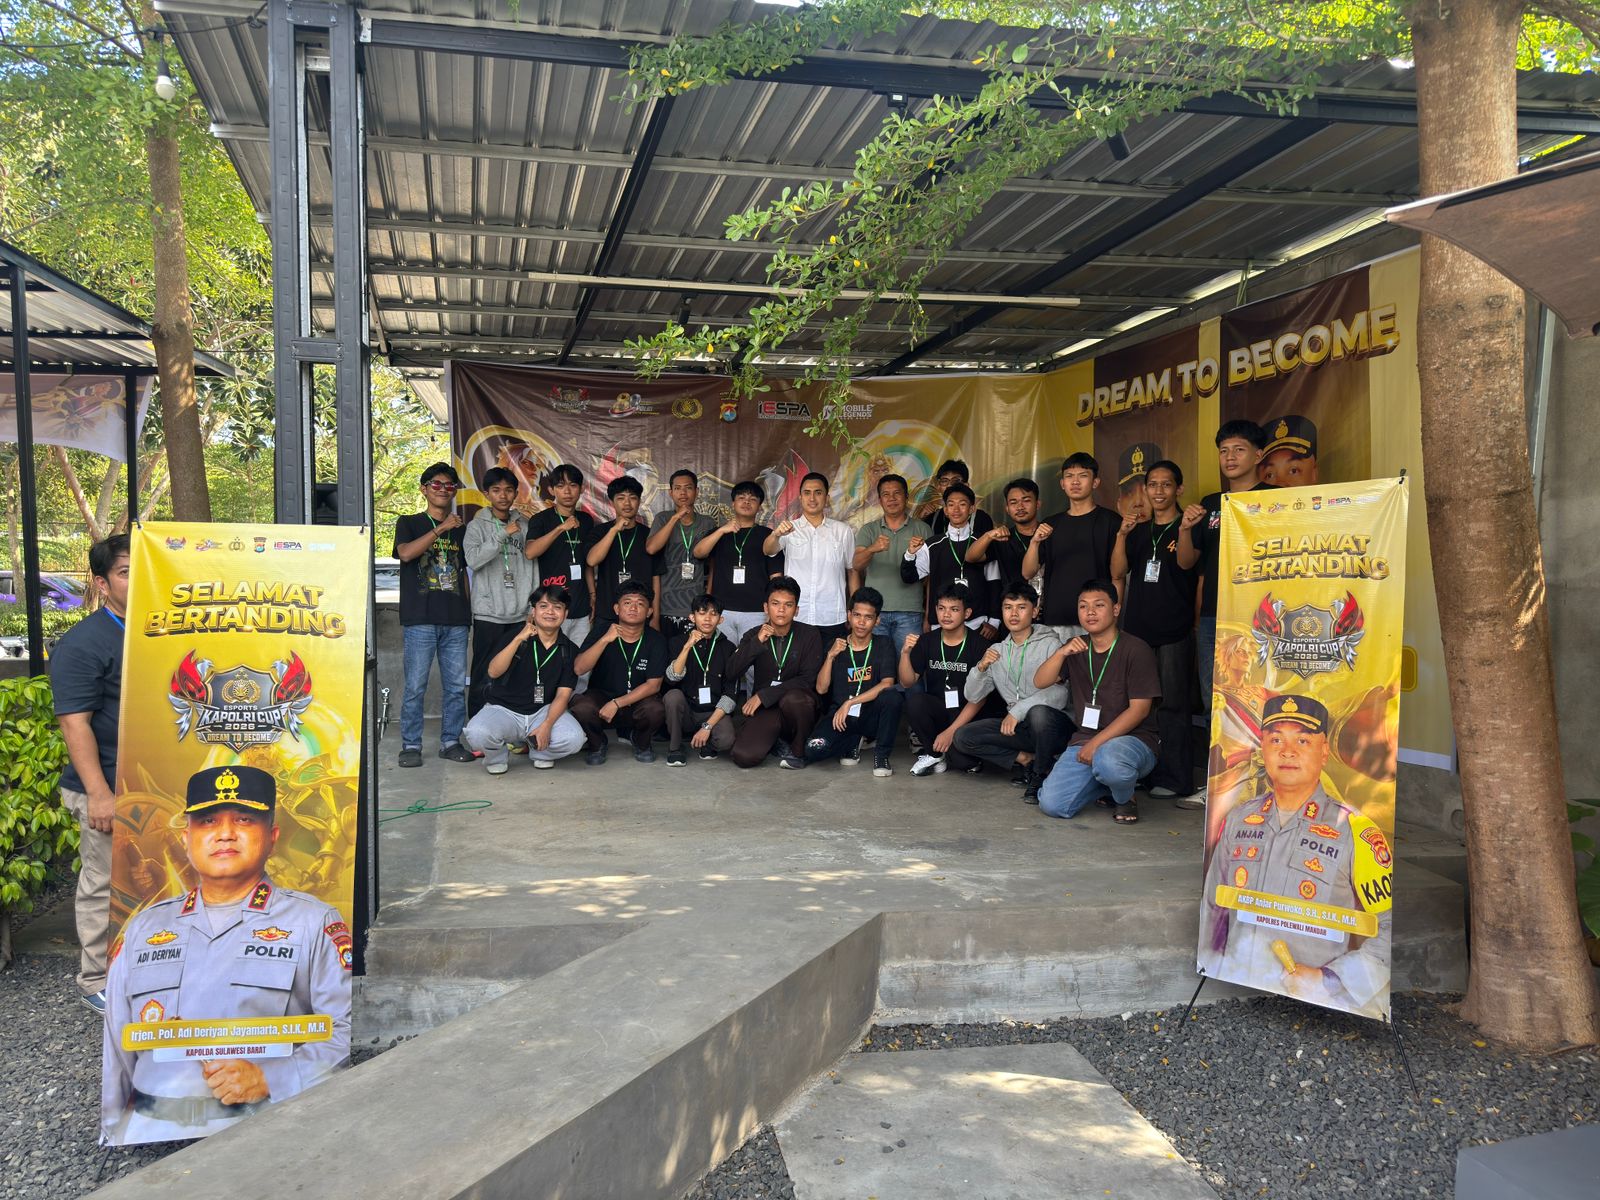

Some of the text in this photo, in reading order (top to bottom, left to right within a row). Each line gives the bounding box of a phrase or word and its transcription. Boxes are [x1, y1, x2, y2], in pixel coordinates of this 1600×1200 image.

[1076, 303, 1400, 427] DREAM TO BECOME
[1250, 534, 1372, 560] SELAMAT
[1232, 554, 1390, 584] BERTANDING
[170, 581, 325, 608] SELAMAT
[144, 606, 346, 639] BERTANDING
[1275, 641, 1339, 656] KAPOLRI CUP
[929, 660, 967, 672] LACOSTE
[199, 708, 281, 727] KAPOLRI CUP
[207, 733, 271, 742] DREAM TO BECOME
[1235, 830, 1264, 839] ANJAR
[1300, 838, 1339, 859] POLRI
[1360, 873, 1392, 905] KAO
[1256, 916, 1327, 936] KAPOLRES POLEWALI MANDAR
[137, 948, 182, 964] ADI DERIYAN
[244, 945, 294, 959] POLRI
[131, 1030, 156, 1042] Irjen.
[158, 1028, 176, 1039] Pol.
[178, 1027, 192, 1038] Adi
[194, 1026, 228, 1038] Deriyan
[230, 1024, 280, 1037] Jayamarta,
[308, 1022, 327, 1033] M.H.
[186, 1046, 266, 1057] KAPOLDA SULAWESI BARAT
